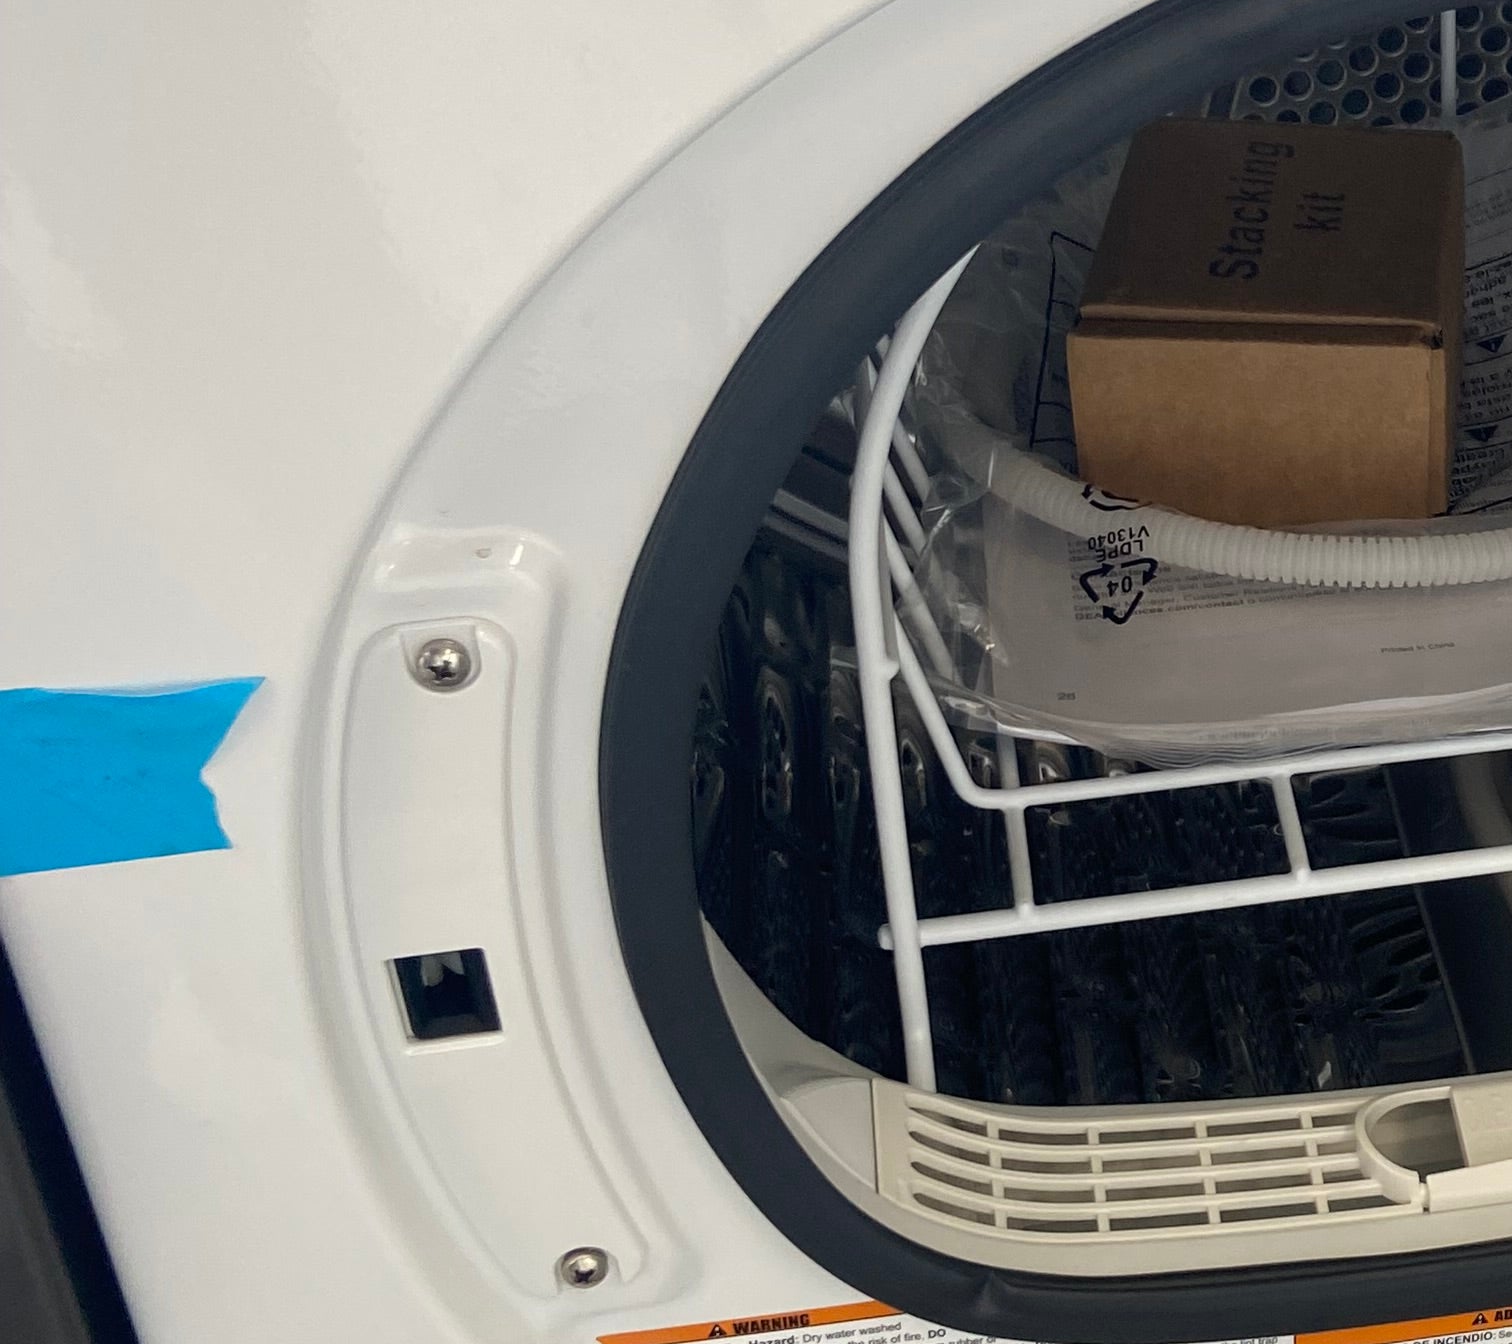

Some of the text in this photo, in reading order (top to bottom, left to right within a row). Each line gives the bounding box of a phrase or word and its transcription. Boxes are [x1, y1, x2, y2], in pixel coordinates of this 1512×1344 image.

[1208, 141, 1295, 280] Stacking
[1293, 192, 1346, 231] kit
[733, 1313, 809, 1335] WARNING
[802, 1332, 821, 1344] Dry
[824, 1328, 856, 1340] water
[859, 1320, 901, 1335] washed
[928, 1327, 946, 1338] DO
